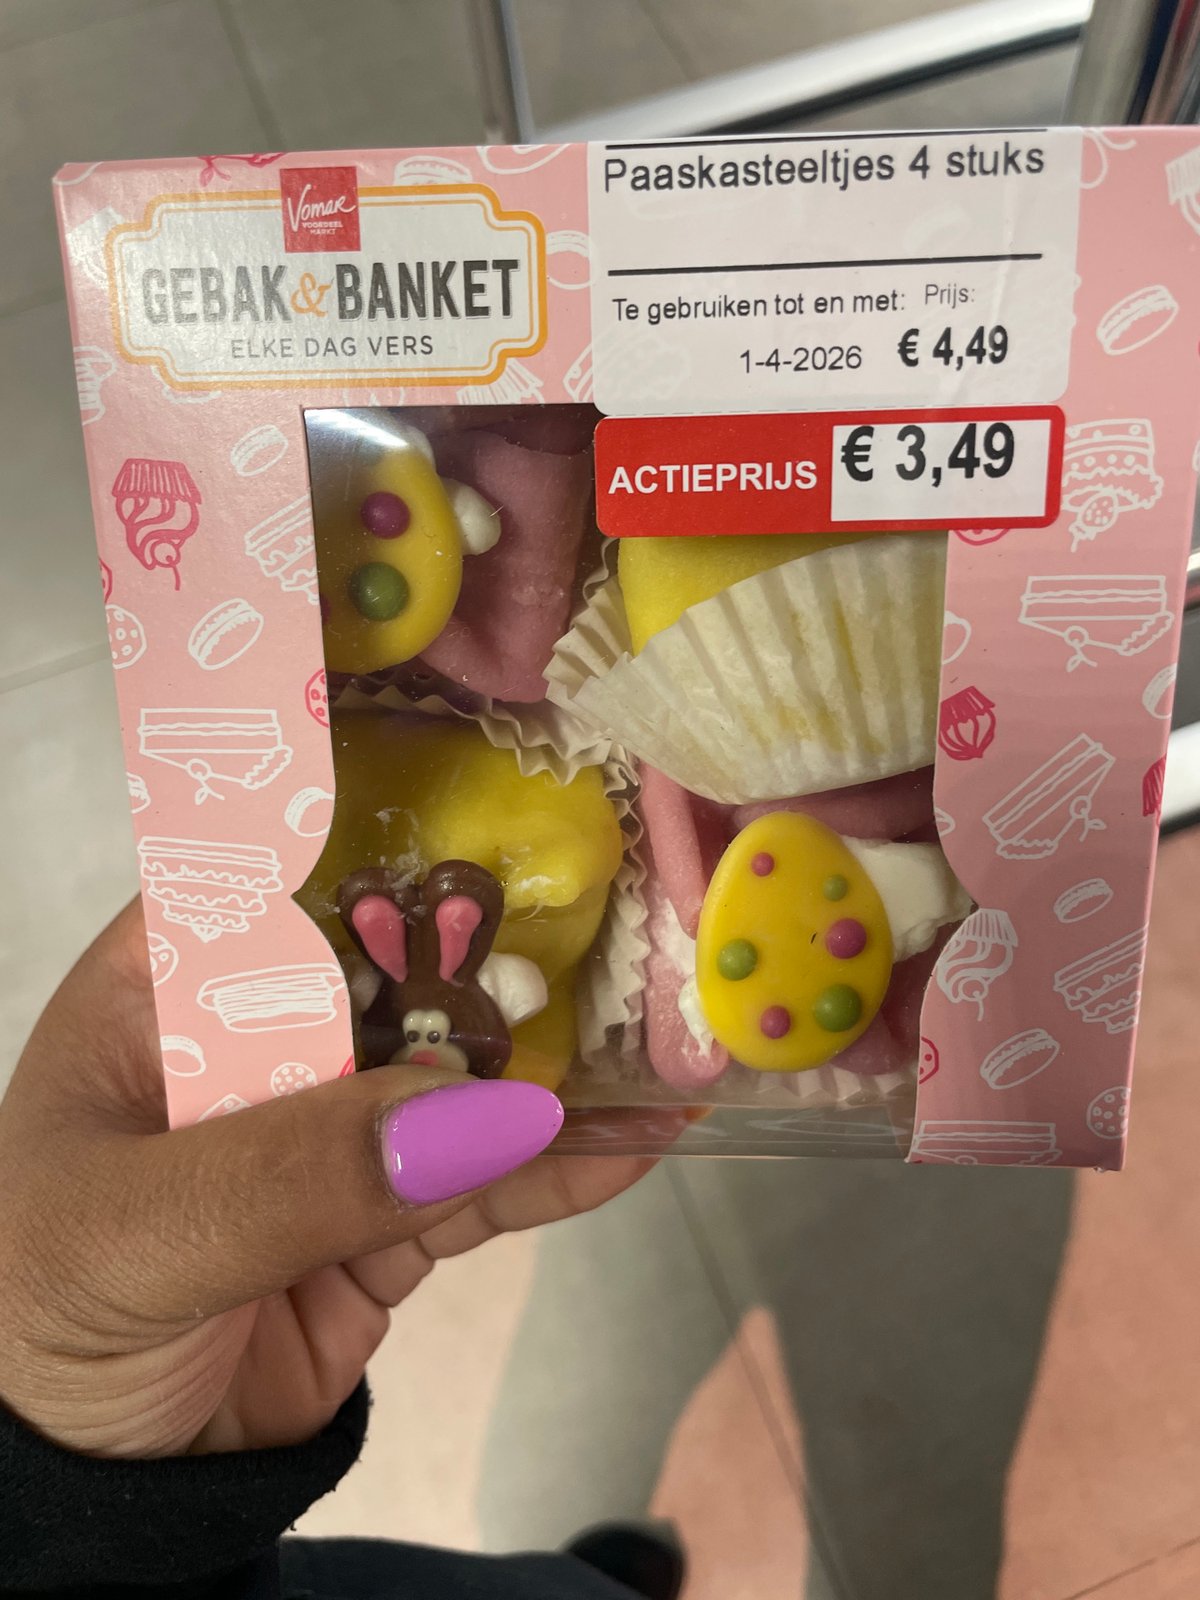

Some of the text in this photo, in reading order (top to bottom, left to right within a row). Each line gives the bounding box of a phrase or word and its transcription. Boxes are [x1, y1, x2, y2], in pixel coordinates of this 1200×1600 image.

[603, 140, 1045, 194] Paaskasteeltjes 4 stuks
[287, 183, 357, 233] Vomar
[142, 263, 293, 326] GEBAK
[335, 259, 520, 322] BANKET
[612, 289, 906, 325] Te gebruiken tot en met:
[923, 282, 976, 310] Prijs:
[231, 334, 434, 359] ELKE DAG VERS
[740, 344, 863, 374] 1-4-2026
[897, 324, 1010, 371] € 4,49
[840, 421, 1016, 488] € 3,49
[607, 460, 818, 495] ACTIEPRIJS
